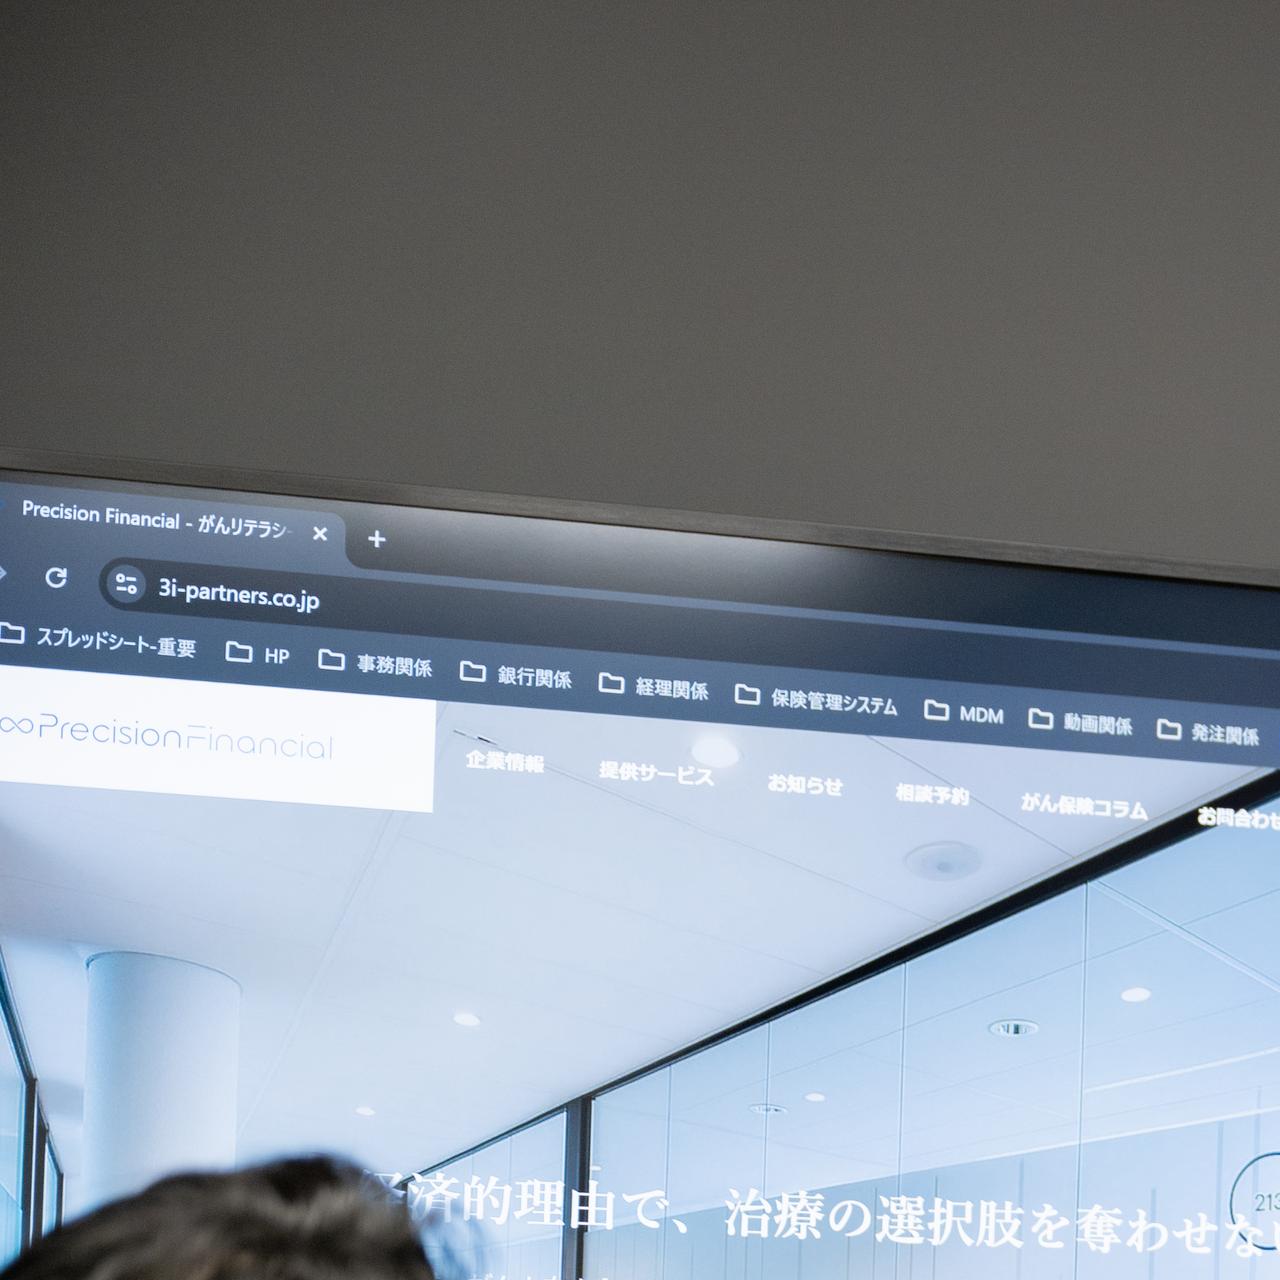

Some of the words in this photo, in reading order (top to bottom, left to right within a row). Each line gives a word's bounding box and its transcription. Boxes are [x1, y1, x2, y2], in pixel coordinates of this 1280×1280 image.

[22, 500, 100, 522] Precision
[105, 508, 180, 529] Financial
[158, 578, 321, 613] 3i-partners.co.jp
[37, 627, 196, 659] スプレッドシート-重要
[265, 648, 290, 664] HP
[356, 652, 433, 679] 事務関係
[498, 665, 572, 689] 銀行関係
[636, 676, 709, 701] 経理関係
[771, 687, 898, 716] 保険管理システム
[960, 706, 1004, 724] MDM
[1064, 712, 1133, 736] 動画関係
[1192, 723, 1259, 746] 発注関係
[465, 749, 545, 774] 企業情報
[599, 760, 715, 787] 提供サービス
[768, 773, 844, 797] お知らせ
[895, 782, 970, 806] 相談予約
[1021, 793, 1149, 821] がん保険コラム
